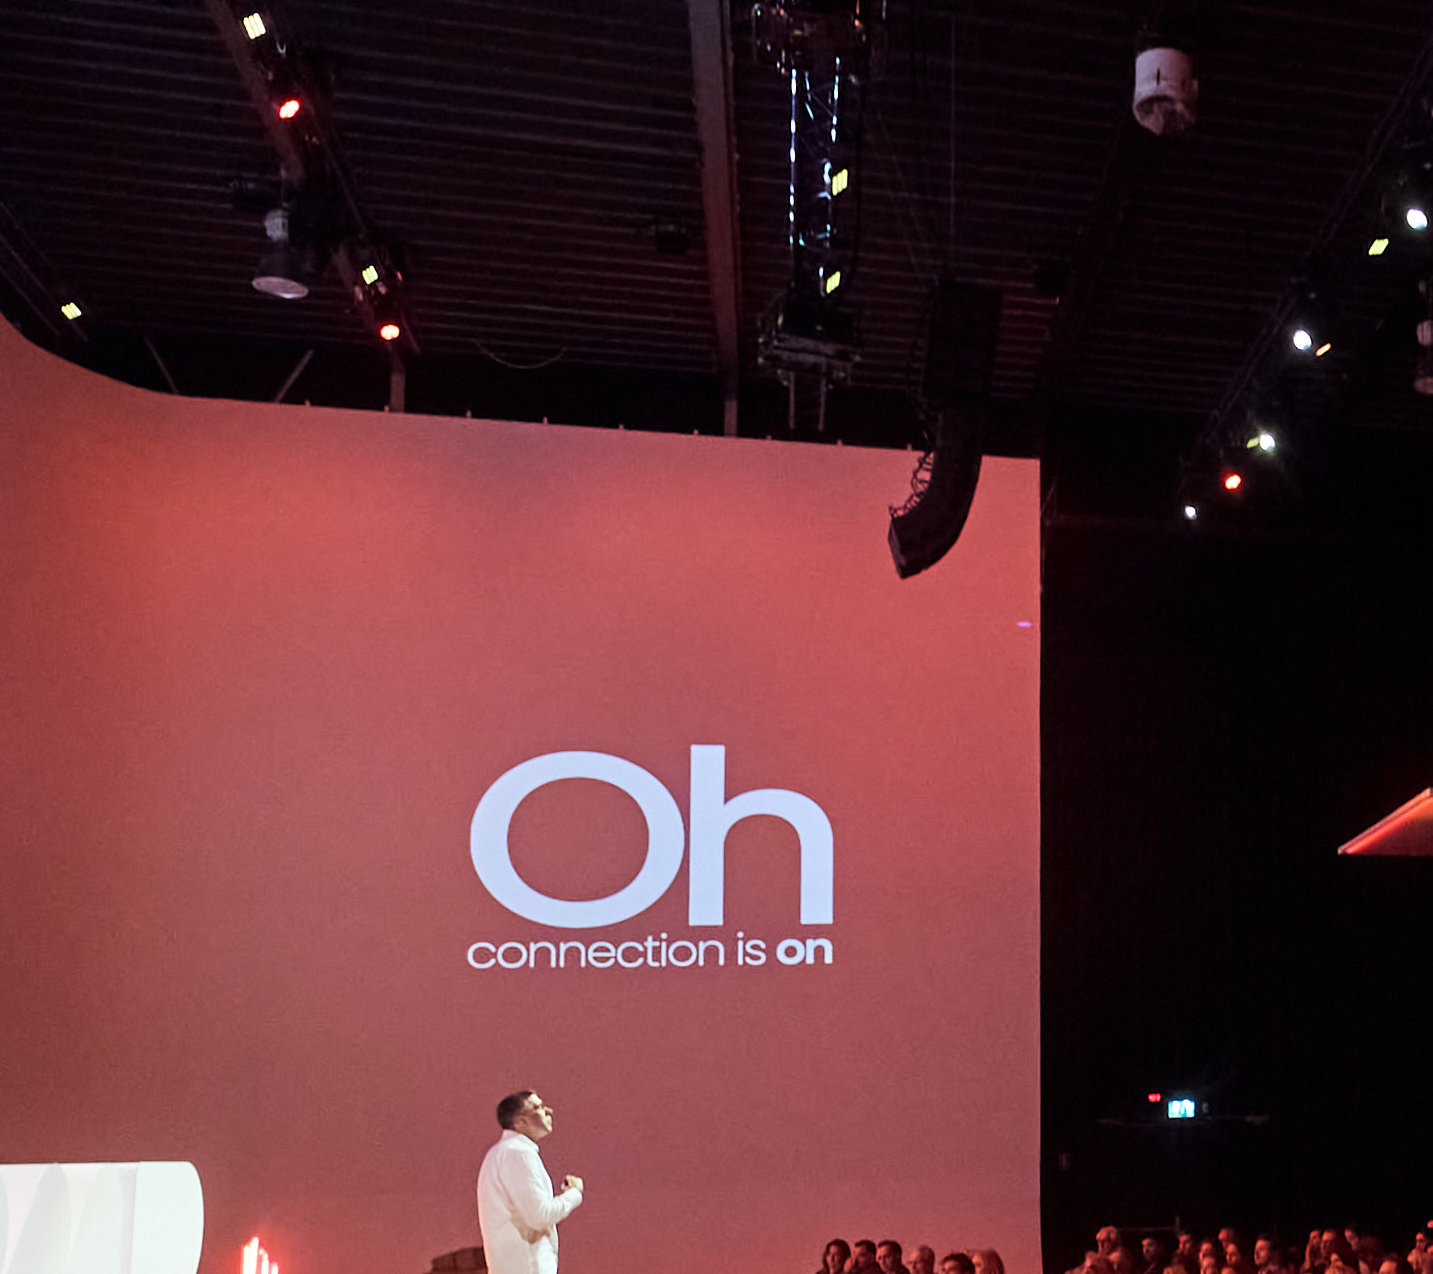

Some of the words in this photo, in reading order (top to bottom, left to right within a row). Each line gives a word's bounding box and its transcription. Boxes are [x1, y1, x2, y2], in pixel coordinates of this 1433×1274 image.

[469, 744, 834, 929] Oh
[466, 932, 725, 969] connection
[736, 931, 767, 966] is
[776, 937, 833, 965] on
